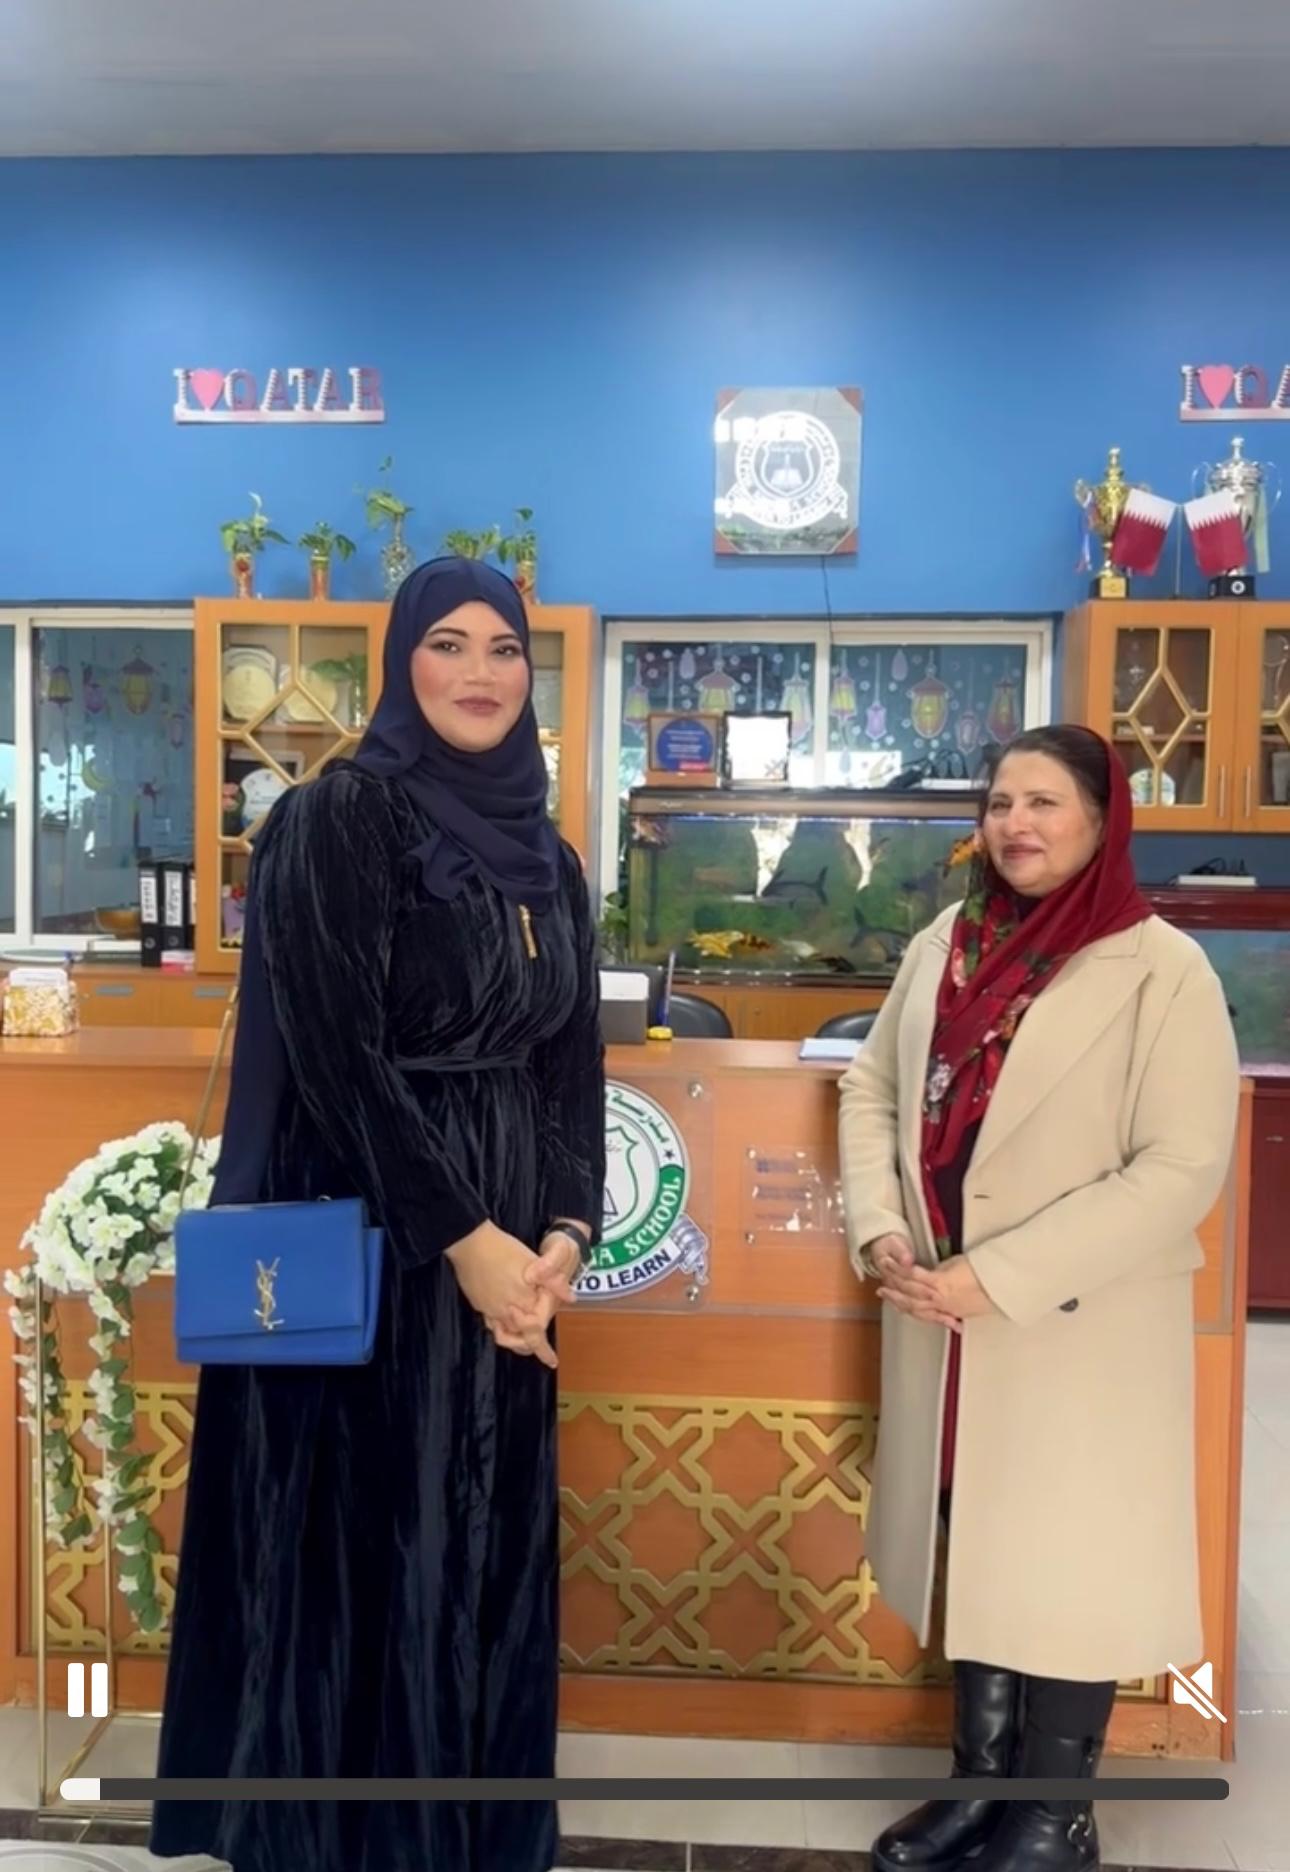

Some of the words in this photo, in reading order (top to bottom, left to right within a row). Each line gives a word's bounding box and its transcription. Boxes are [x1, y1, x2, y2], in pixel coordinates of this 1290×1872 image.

[173, 367, 189, 411] I
[223, 367, 384, 411] QATAR
[1181, 365, 1197, 410] I
[623, 1176, 681, 1256] SCHOOL
[607, 1249, 671, 1289] LEARN
